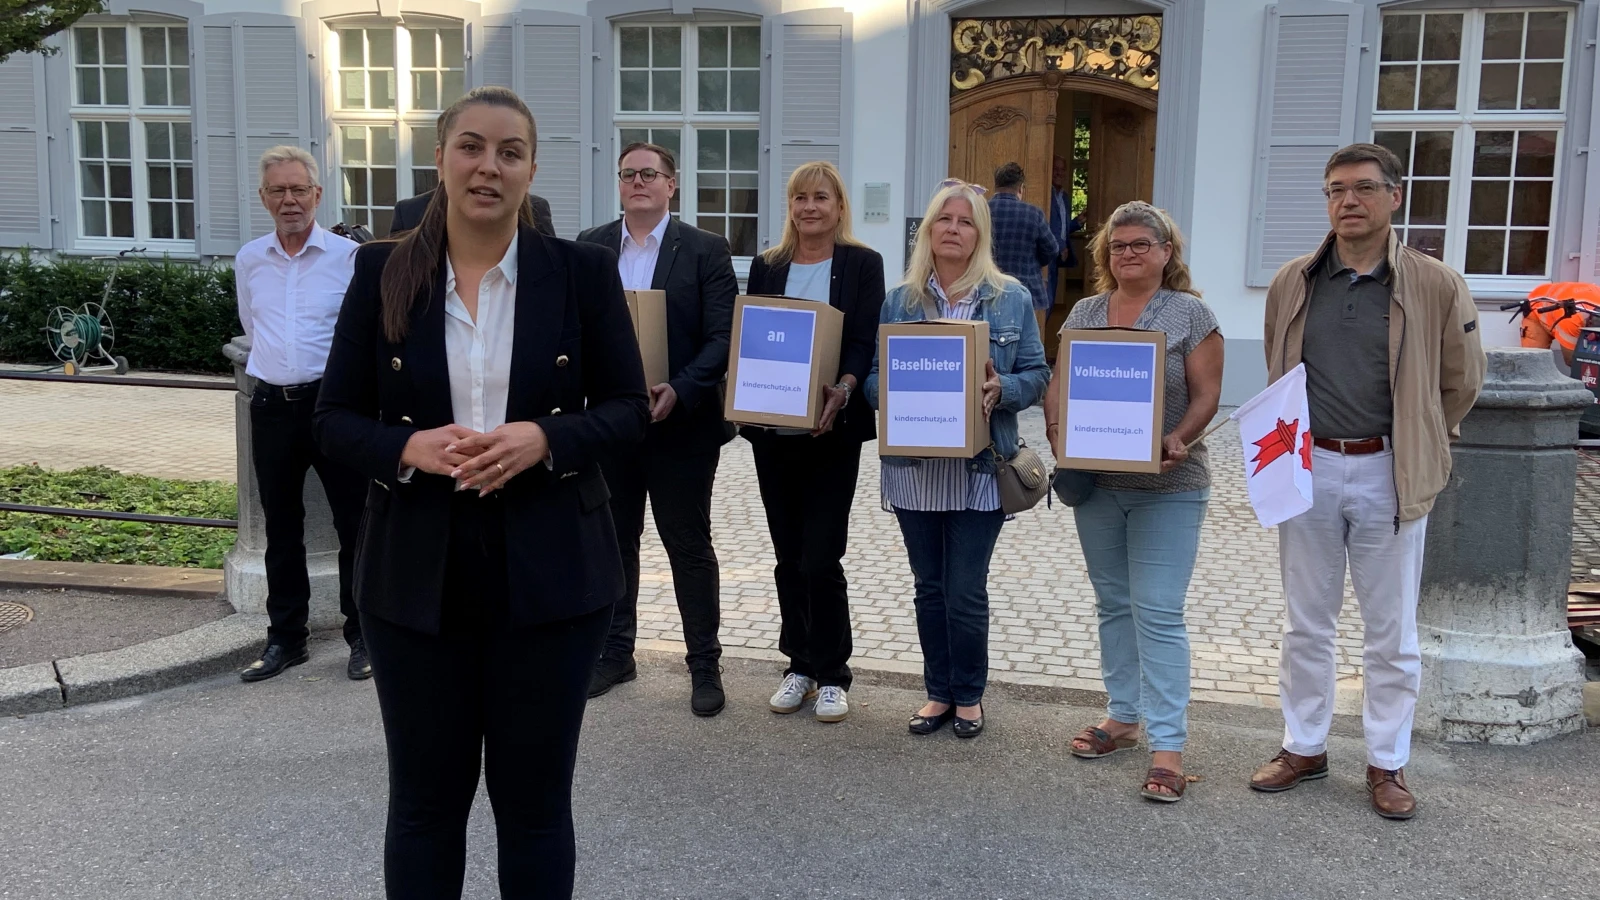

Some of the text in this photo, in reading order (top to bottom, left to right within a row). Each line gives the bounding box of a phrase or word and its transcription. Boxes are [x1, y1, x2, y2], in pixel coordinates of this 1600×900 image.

[767, 330, 785, 343] an
[891, 358, 962, 371] Baselbieter
[1074, 366, 1149, 379] Volksschulen
[742, 381, 802, 393] kinderschutzja.ch
[894, 415, 958, 424] kinderschutzja.ch
[1074, 425, 1144, 435] kinderschutzja.ch
